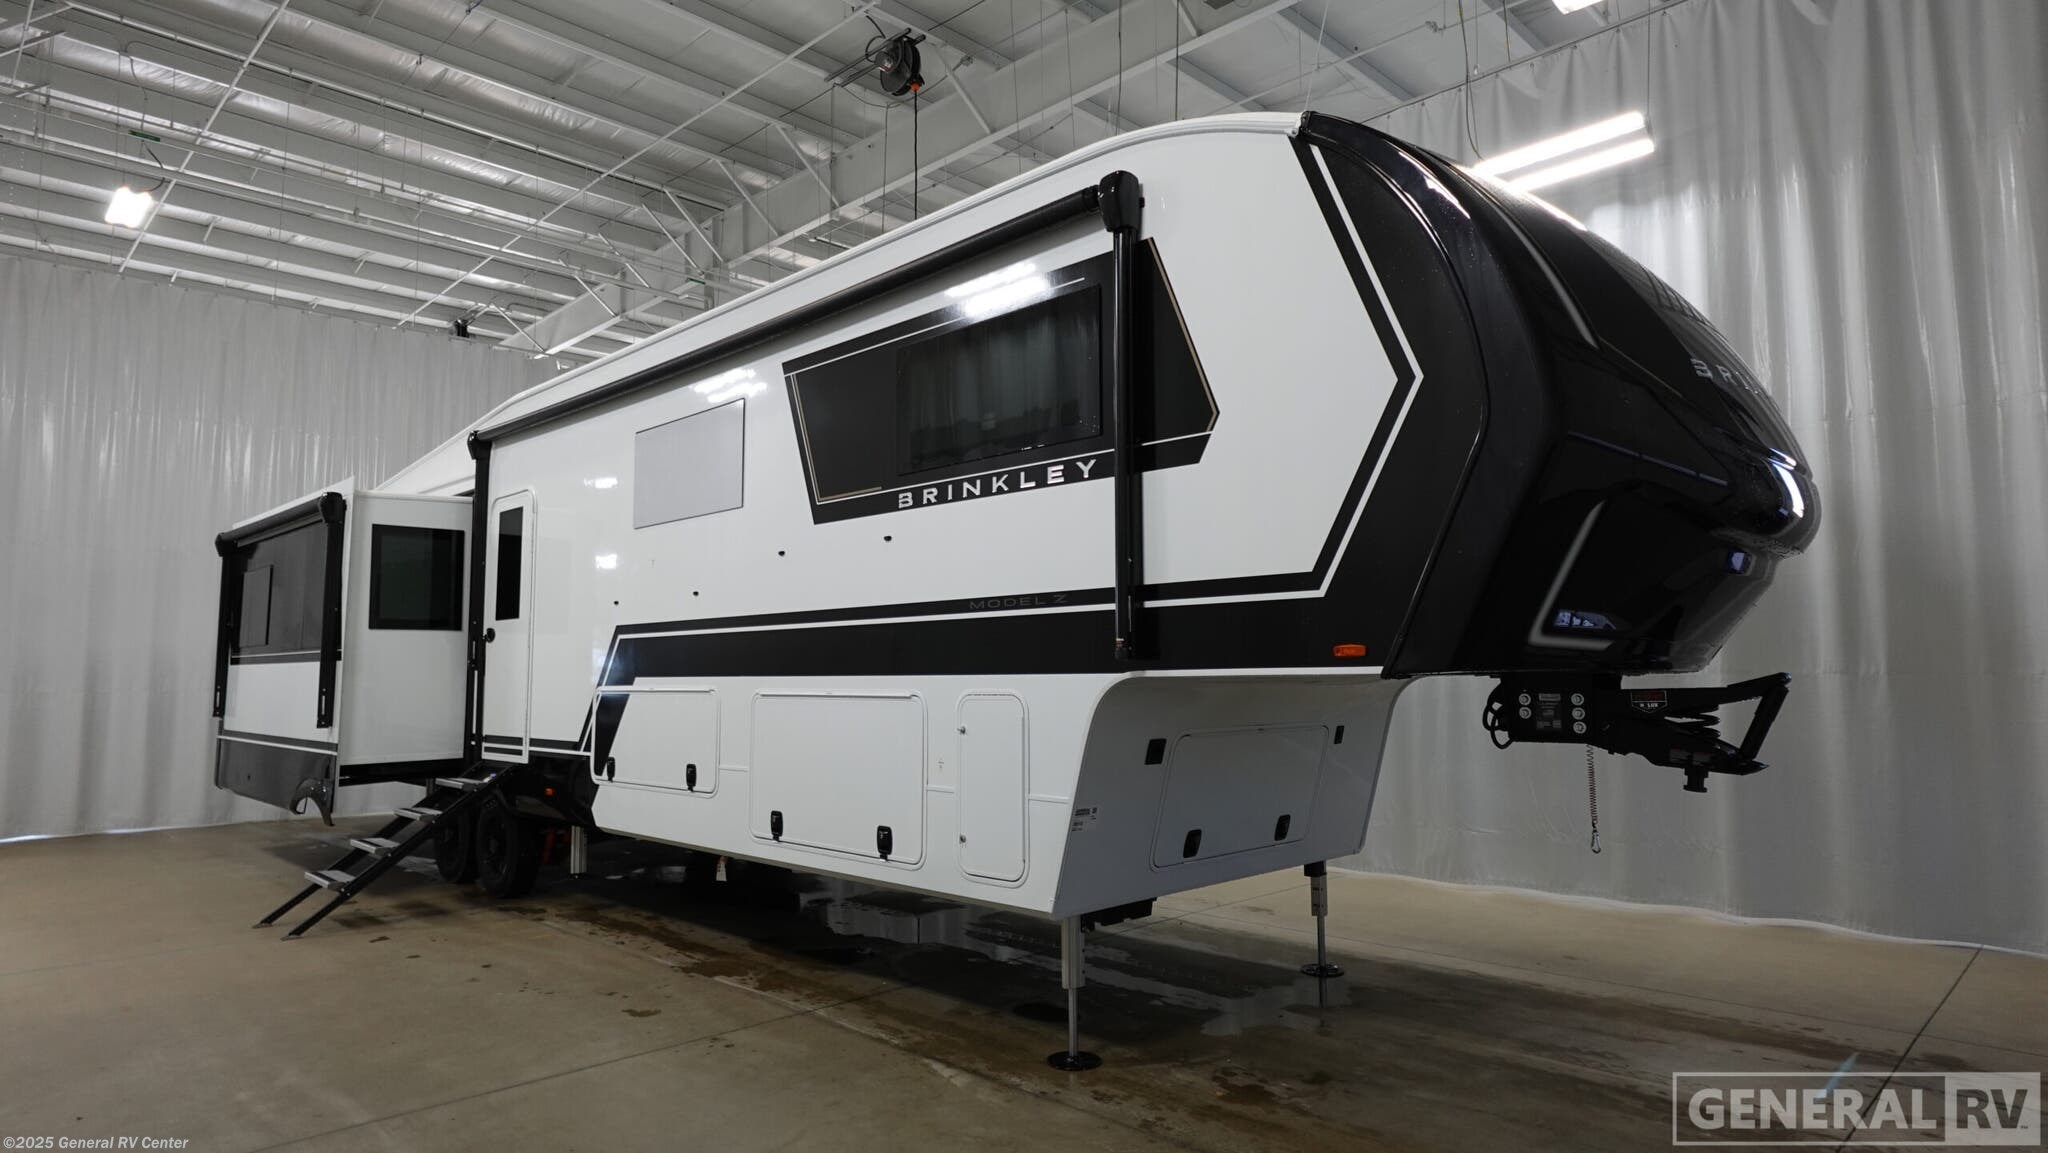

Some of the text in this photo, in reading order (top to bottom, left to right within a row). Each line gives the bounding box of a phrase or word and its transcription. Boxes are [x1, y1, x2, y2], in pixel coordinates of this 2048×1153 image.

[898, 459, 1096, 509] BRINKLEY
[969, 594, 1067, 609] MODEL Z
